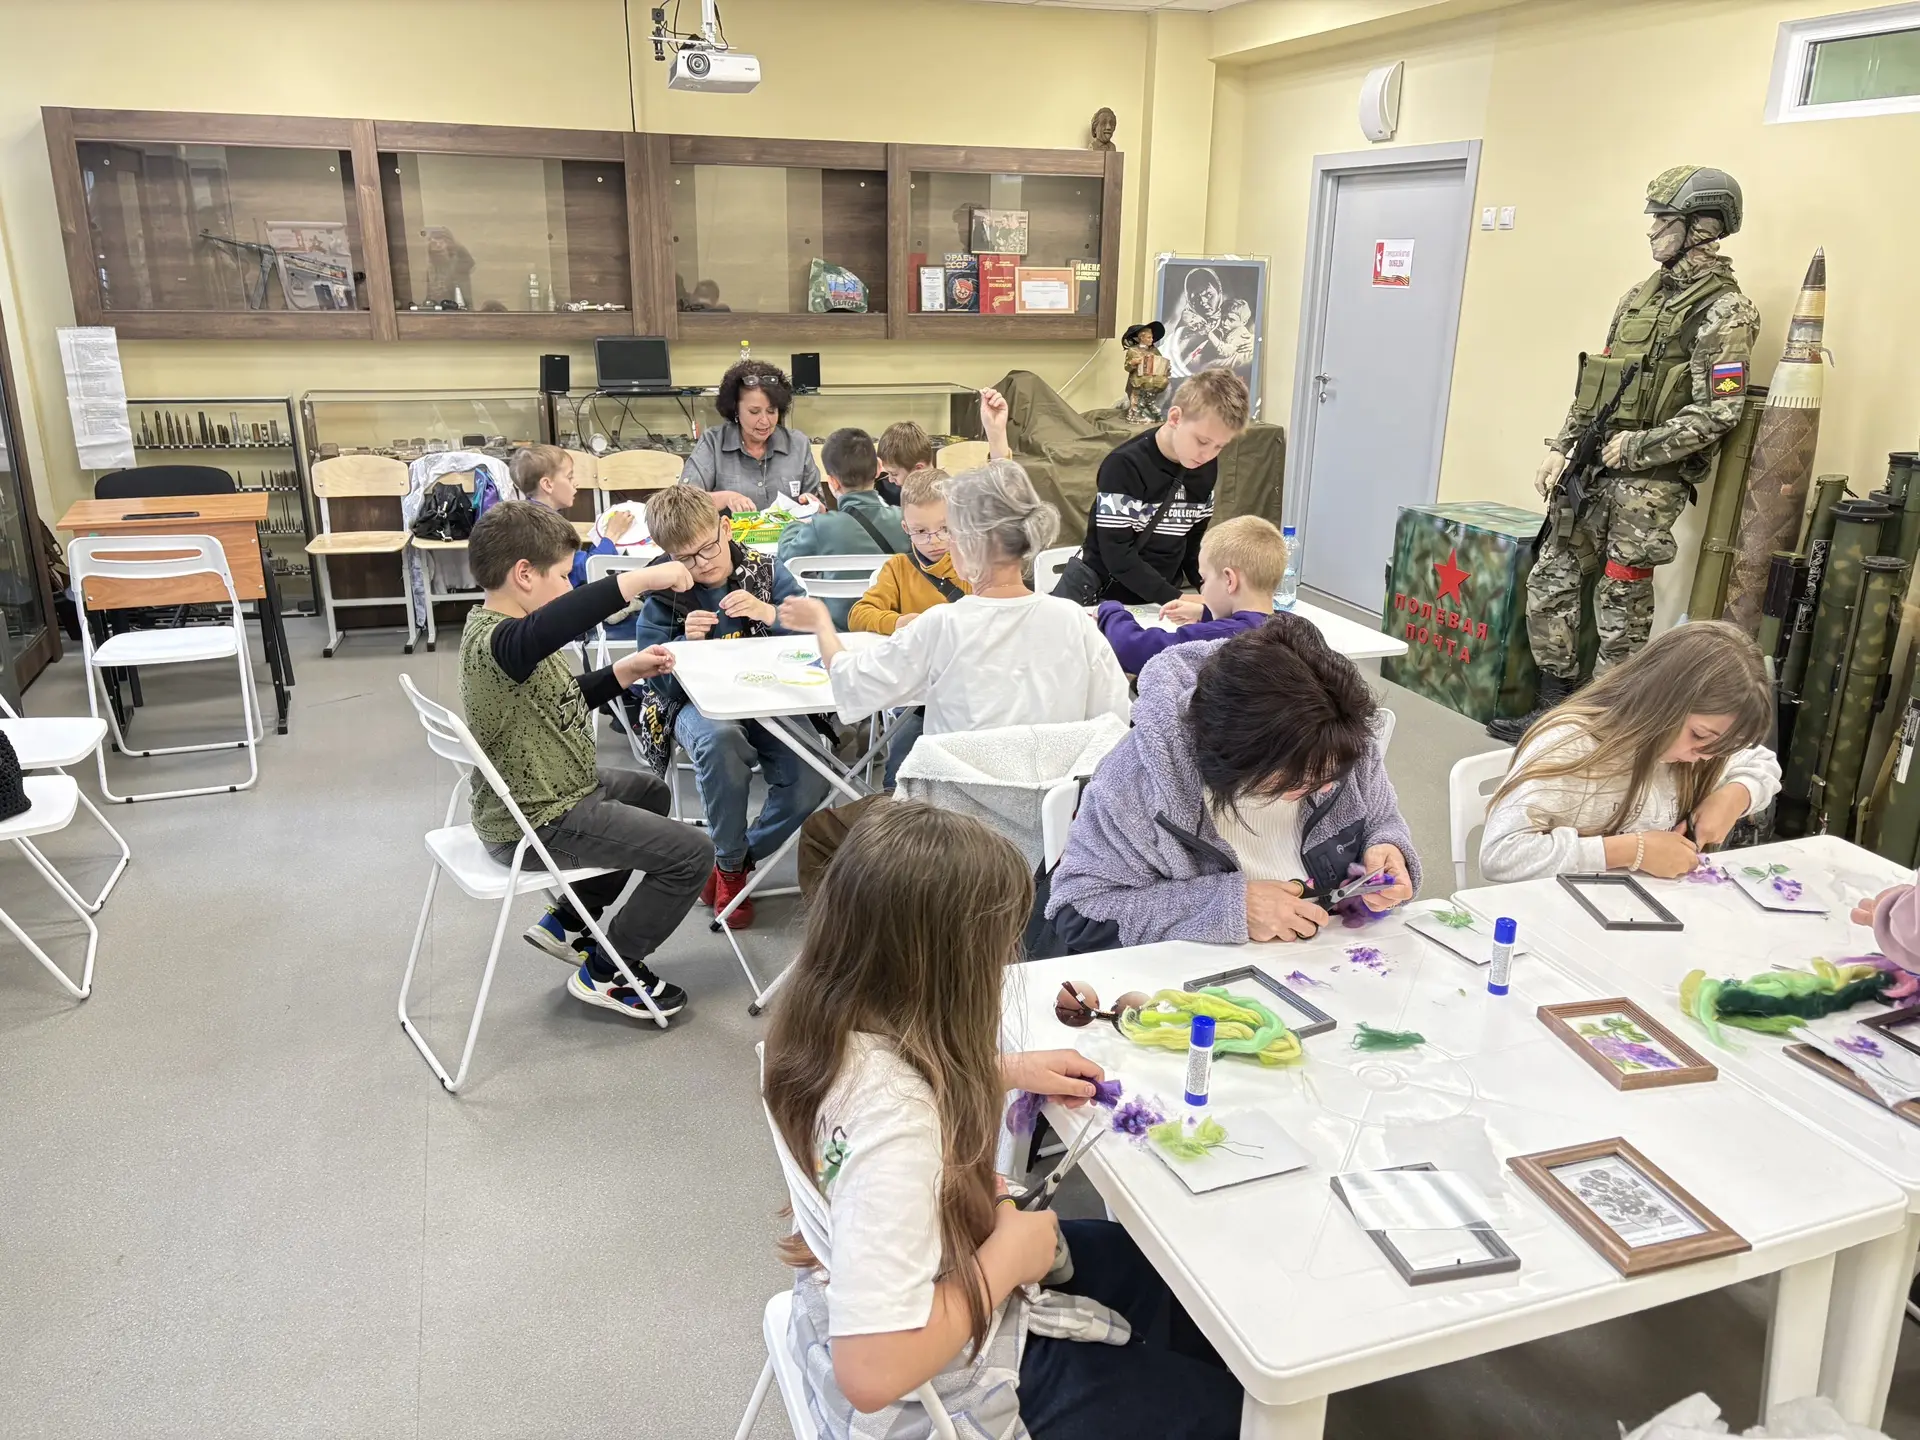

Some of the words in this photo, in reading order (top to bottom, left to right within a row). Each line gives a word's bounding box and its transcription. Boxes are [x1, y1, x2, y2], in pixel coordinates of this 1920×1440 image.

[945, 261, 968, 269] СССР
[1394, 592, 1488, 641] ПОЛЕВАЯ
[1405, 623, 1471, 664] ПОЧТА
